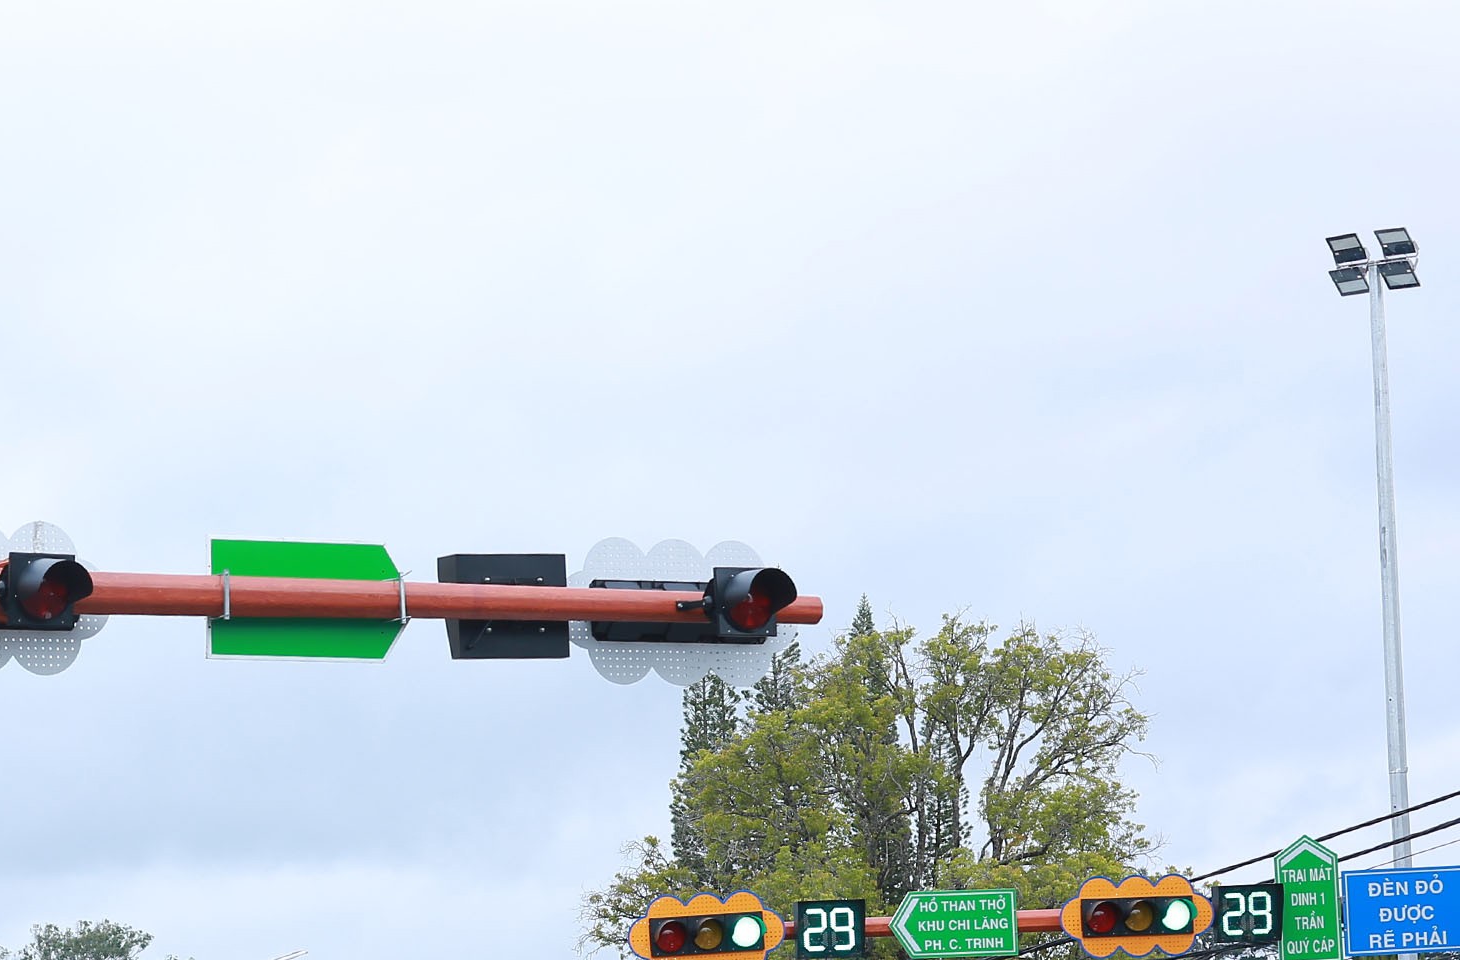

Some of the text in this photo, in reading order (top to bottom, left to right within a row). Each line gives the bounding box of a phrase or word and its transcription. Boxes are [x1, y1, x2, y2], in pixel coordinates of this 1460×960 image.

[1282, 865, 1332, 886] TRẠI MÁT
[1368, 873, 1443, 897] ĐÈN ĐỎ
[941, 899, 976, 912] THAN
[979, 895, 1006, 911] THỞ
[1291, 892, 1325, 906] DINH 1
[1222, 891, 1272, 936] 29
[1295, 911, 1324, 930] TRẦN
[1379, 904, 1435, 924] ĐƯỢC
[803, 907, 855, 951] 29
[918, 916, 1008, 931] KHU CHI LĂNG
[925, 937, 1004, 950] PH. C. TRINH
[1287, 936, 1335, 954] QUÝ CÁP
[1369, 925, 1447, 949] RẼ PHẢI
